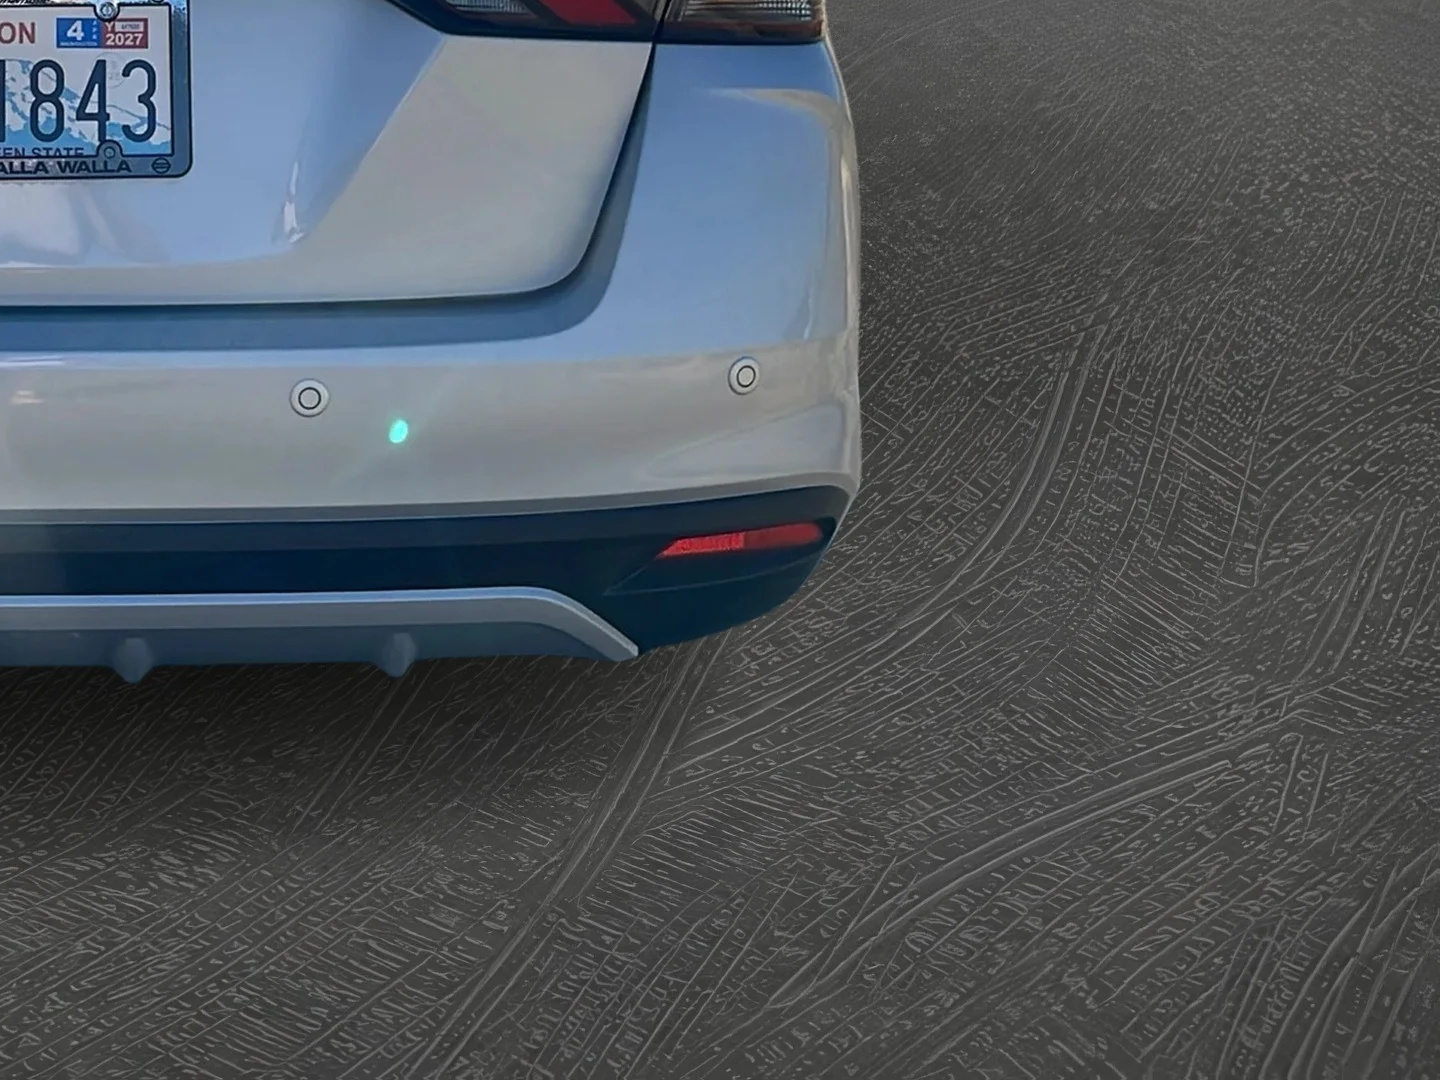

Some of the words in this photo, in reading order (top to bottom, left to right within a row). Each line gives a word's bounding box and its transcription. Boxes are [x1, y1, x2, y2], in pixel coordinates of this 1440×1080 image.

[66, 20, 84, 41] 4
[105, 33, 143, 46] 2027
[34, 147, 85, 156] STATE
[56, 159, 133, 174] WALLA
